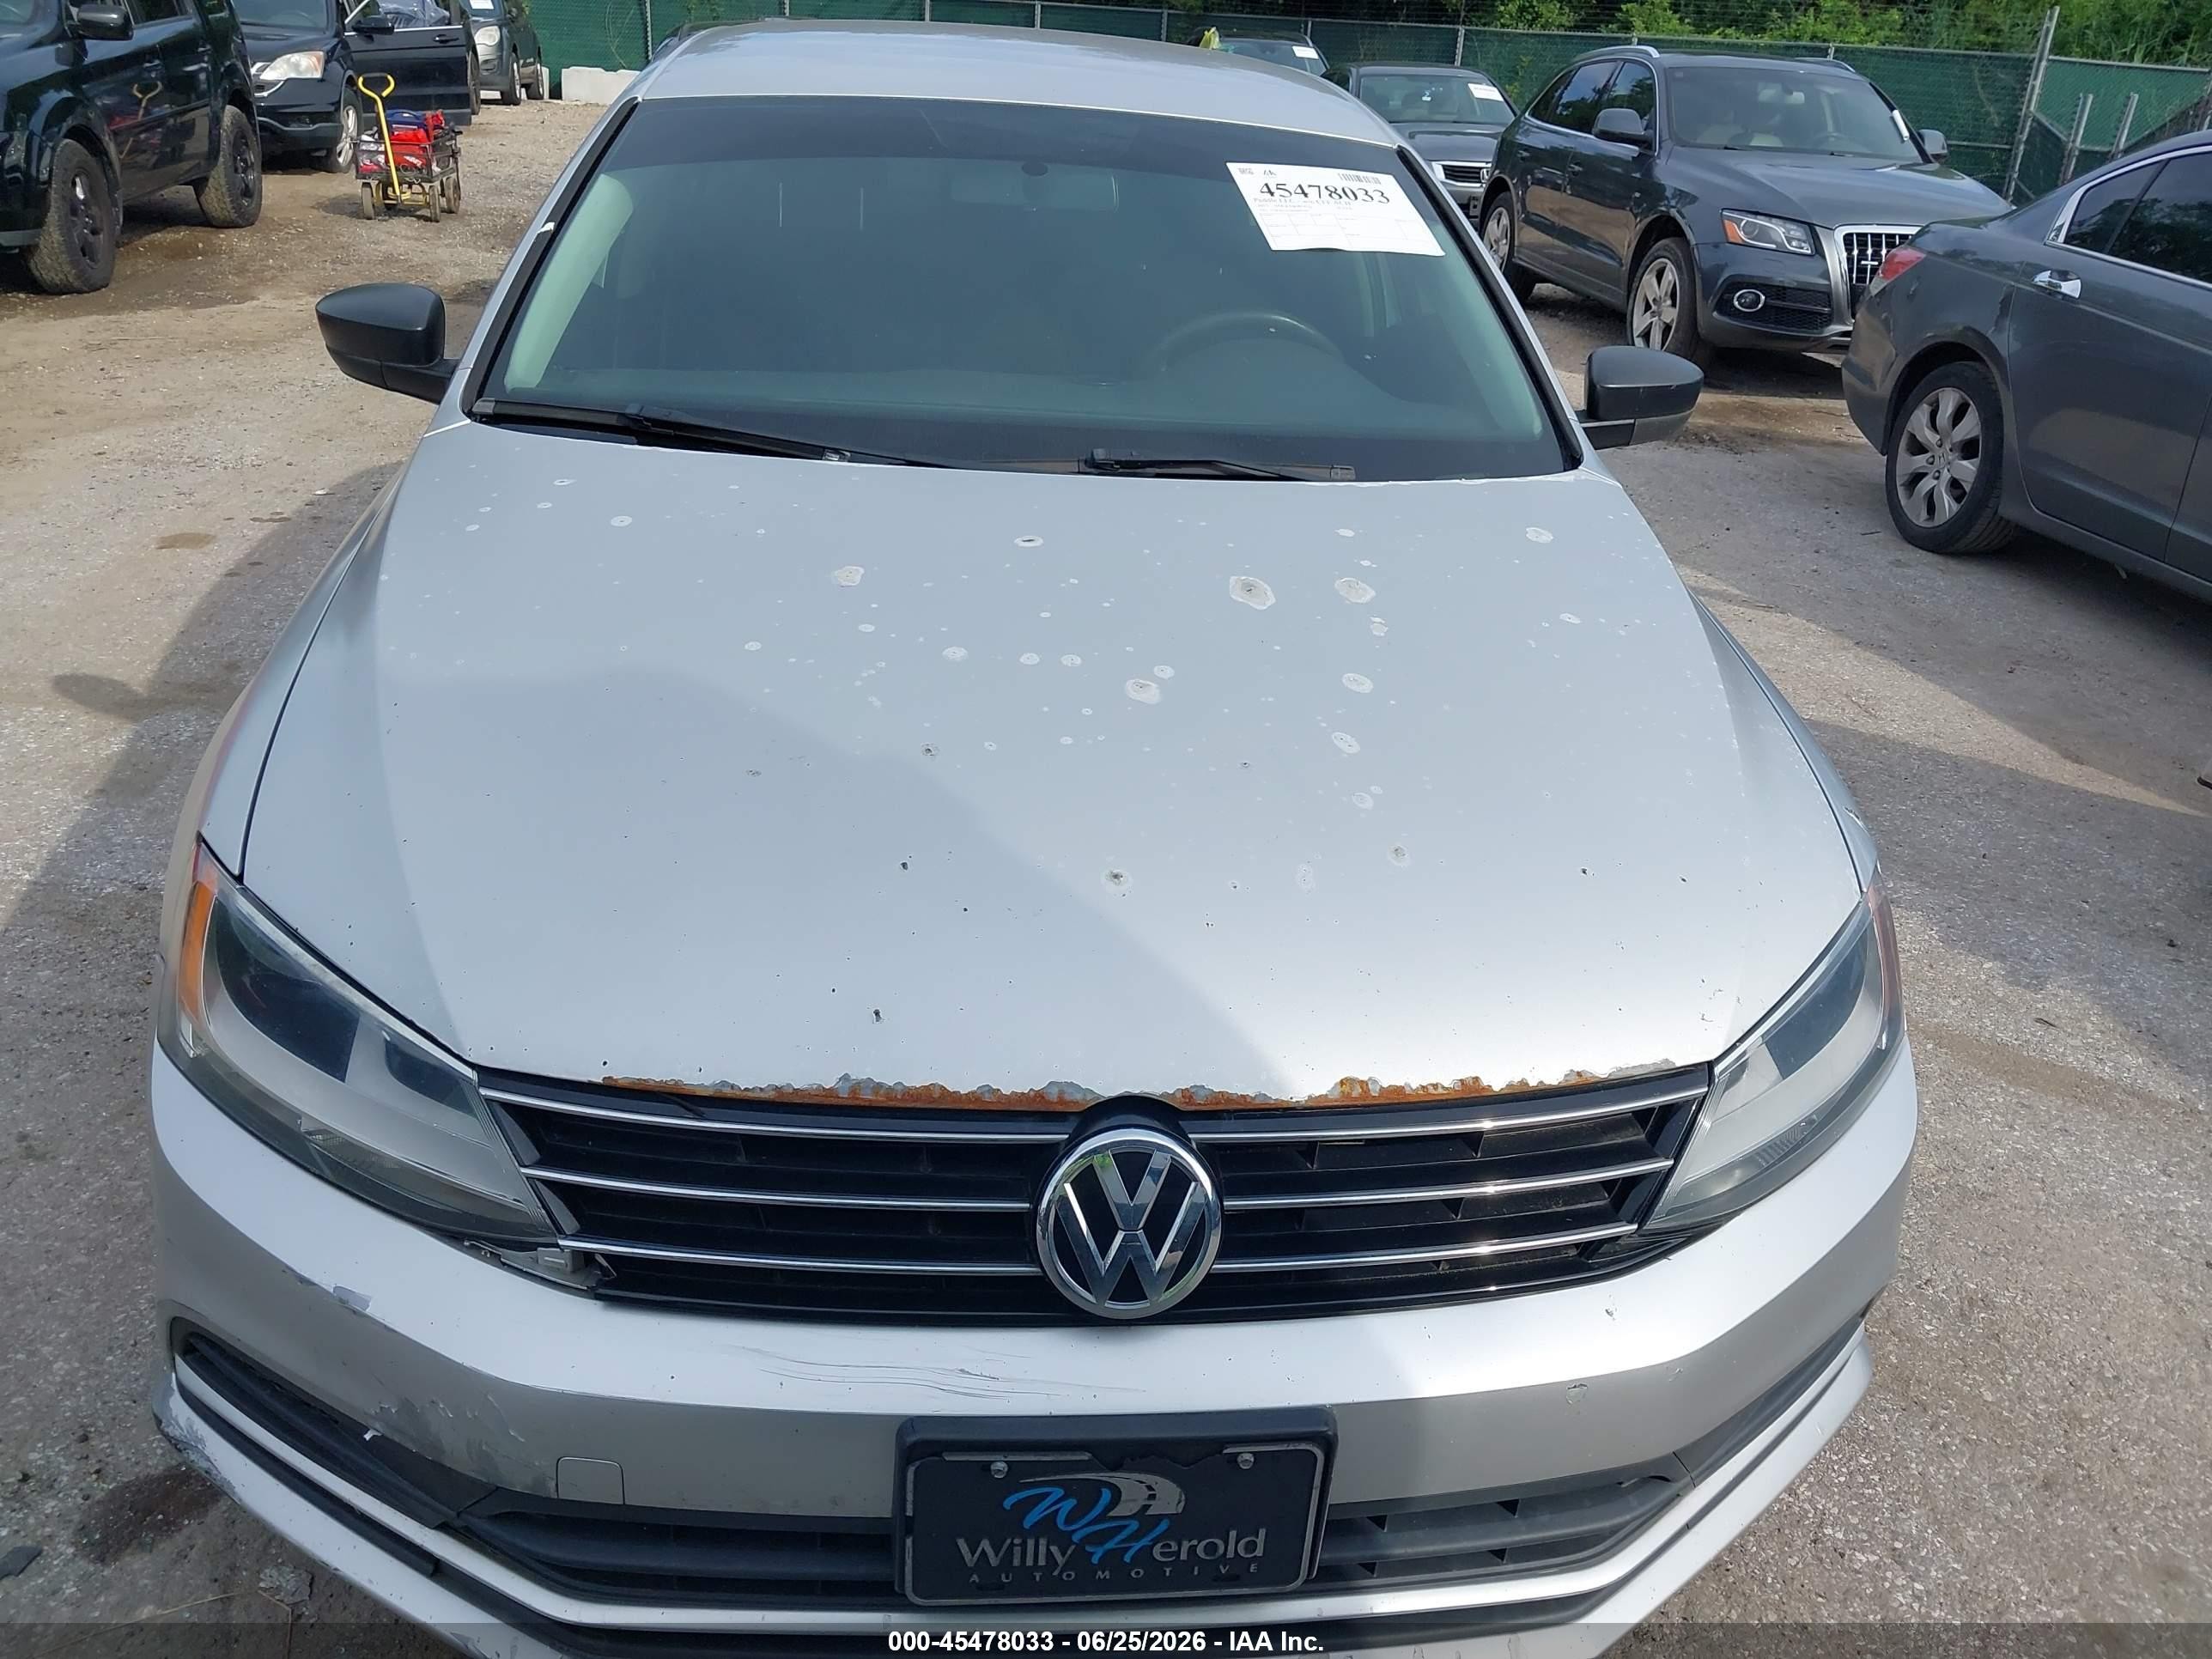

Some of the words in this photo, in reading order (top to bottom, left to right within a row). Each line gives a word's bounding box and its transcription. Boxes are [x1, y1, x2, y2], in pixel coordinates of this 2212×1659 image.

[1260, 182, 1390, 205] 45478033
[957, 1537, 1076, 1575] Willy
[969, 1561, 1259, 1583] AUTOMOTIVE
